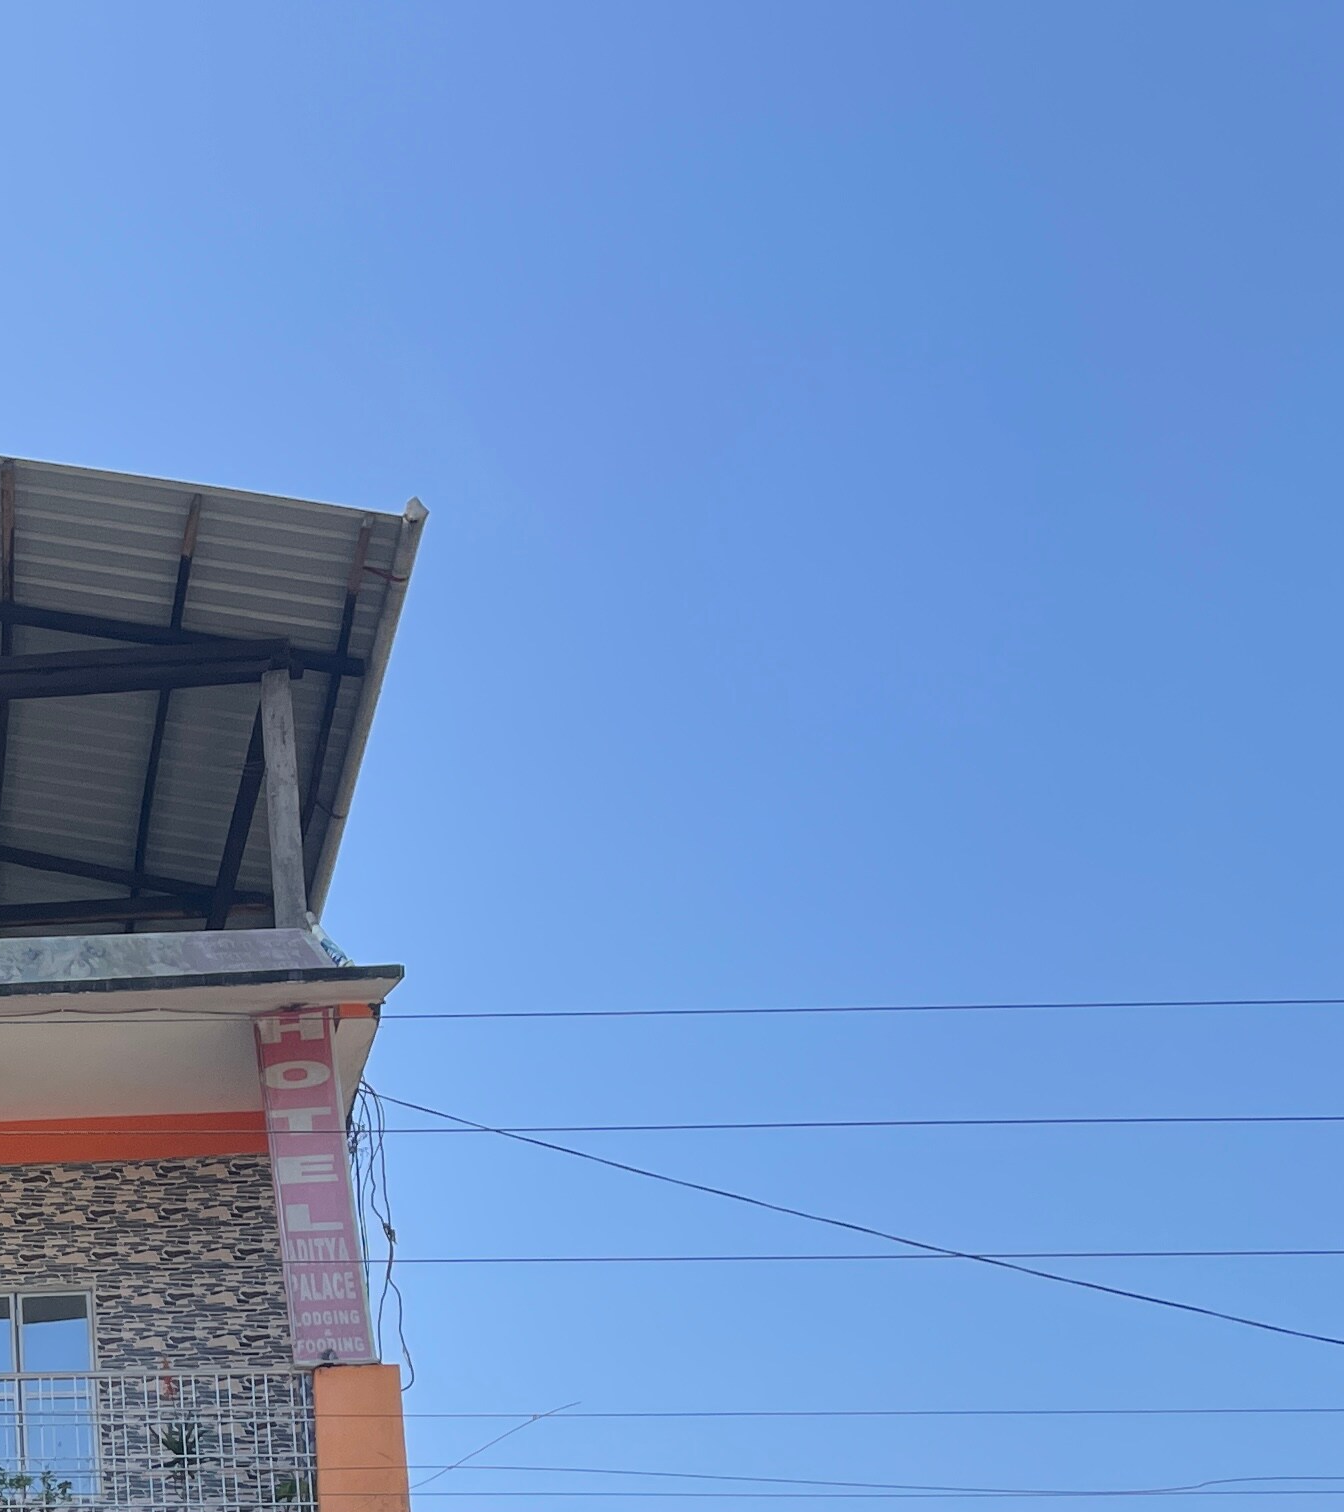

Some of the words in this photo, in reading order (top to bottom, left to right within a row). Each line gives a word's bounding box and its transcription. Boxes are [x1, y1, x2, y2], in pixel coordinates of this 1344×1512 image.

[260, 1011, 344, 1232] HOTEL
[288, 1237, 350, 1266] ADITYA
[291, 1272, 357, 1301] PALACE
[296, 1336, 365, 1354] FOODING
